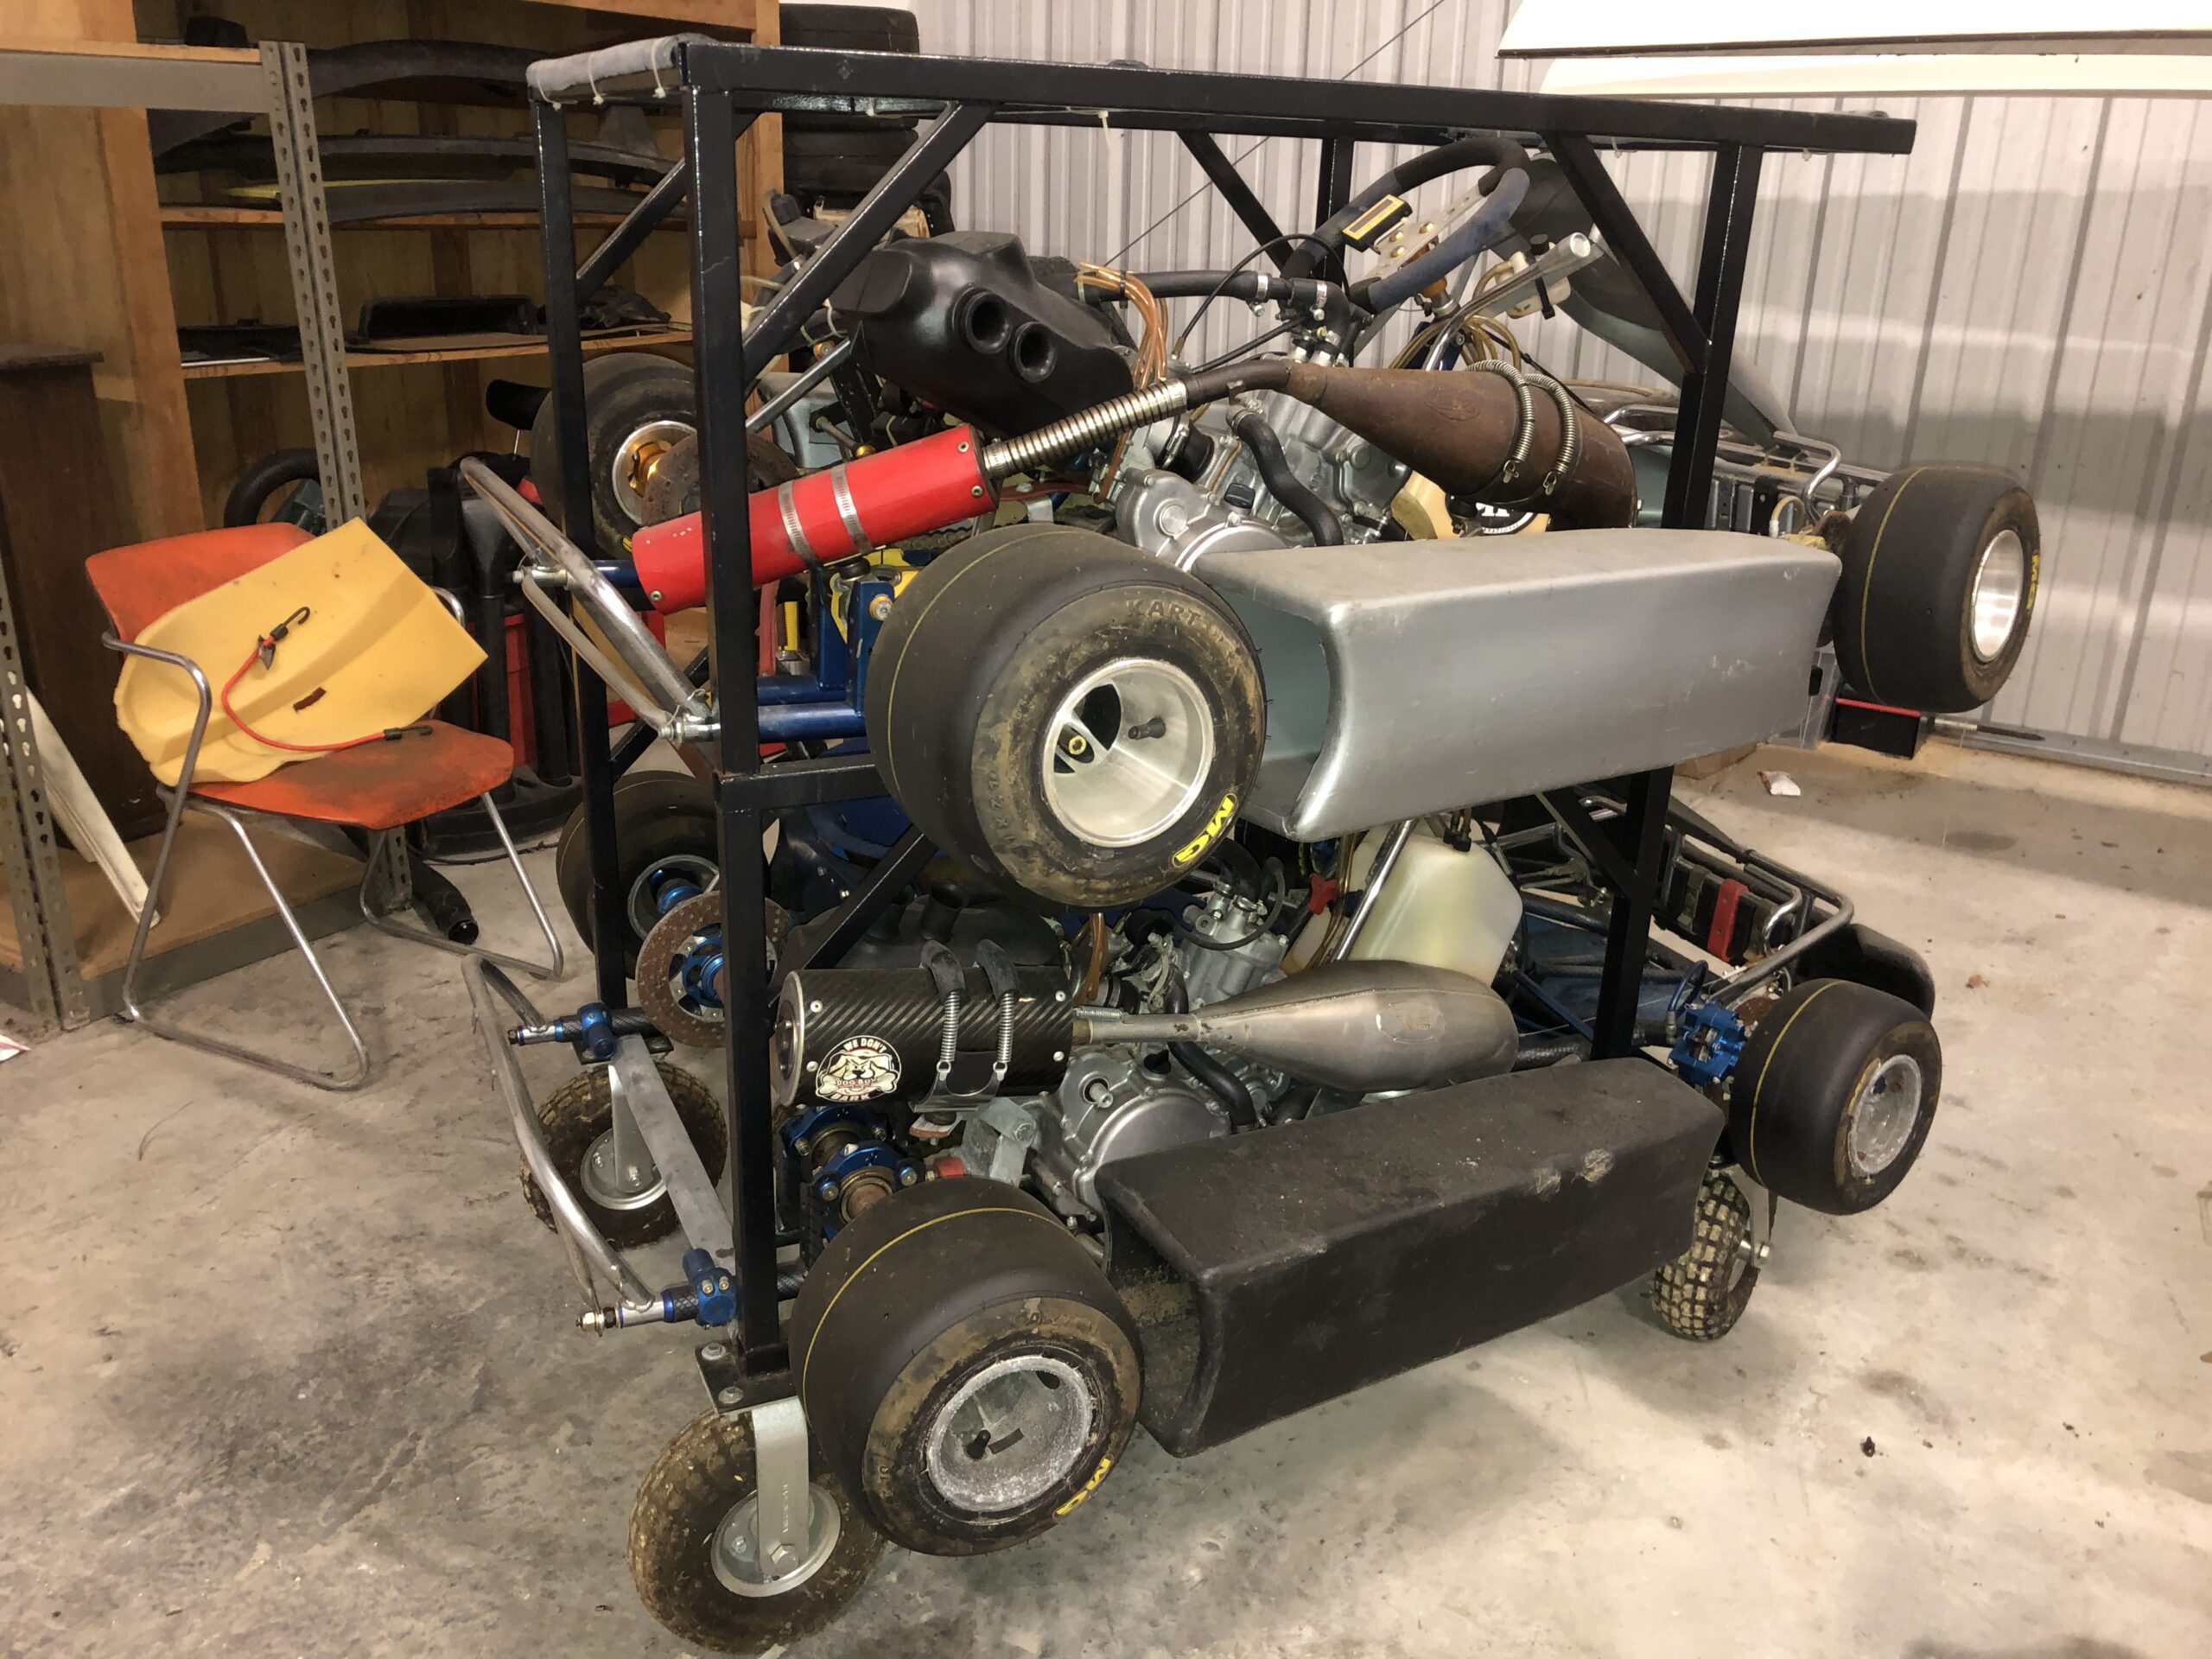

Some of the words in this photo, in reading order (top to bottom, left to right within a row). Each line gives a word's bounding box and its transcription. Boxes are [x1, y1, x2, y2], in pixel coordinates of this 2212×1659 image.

[2025, 555, 2038, 610] MG
[1126, 599, 1201, 626] KART
[1174, 796, 1235, 863] MG
[842, 1039, 859, 1052] WE
[861, 1038, 887, 1053] DON'T
[830, 1093, 871, 1102] BARK
[1055, 1457, 1112, 1516] MG
